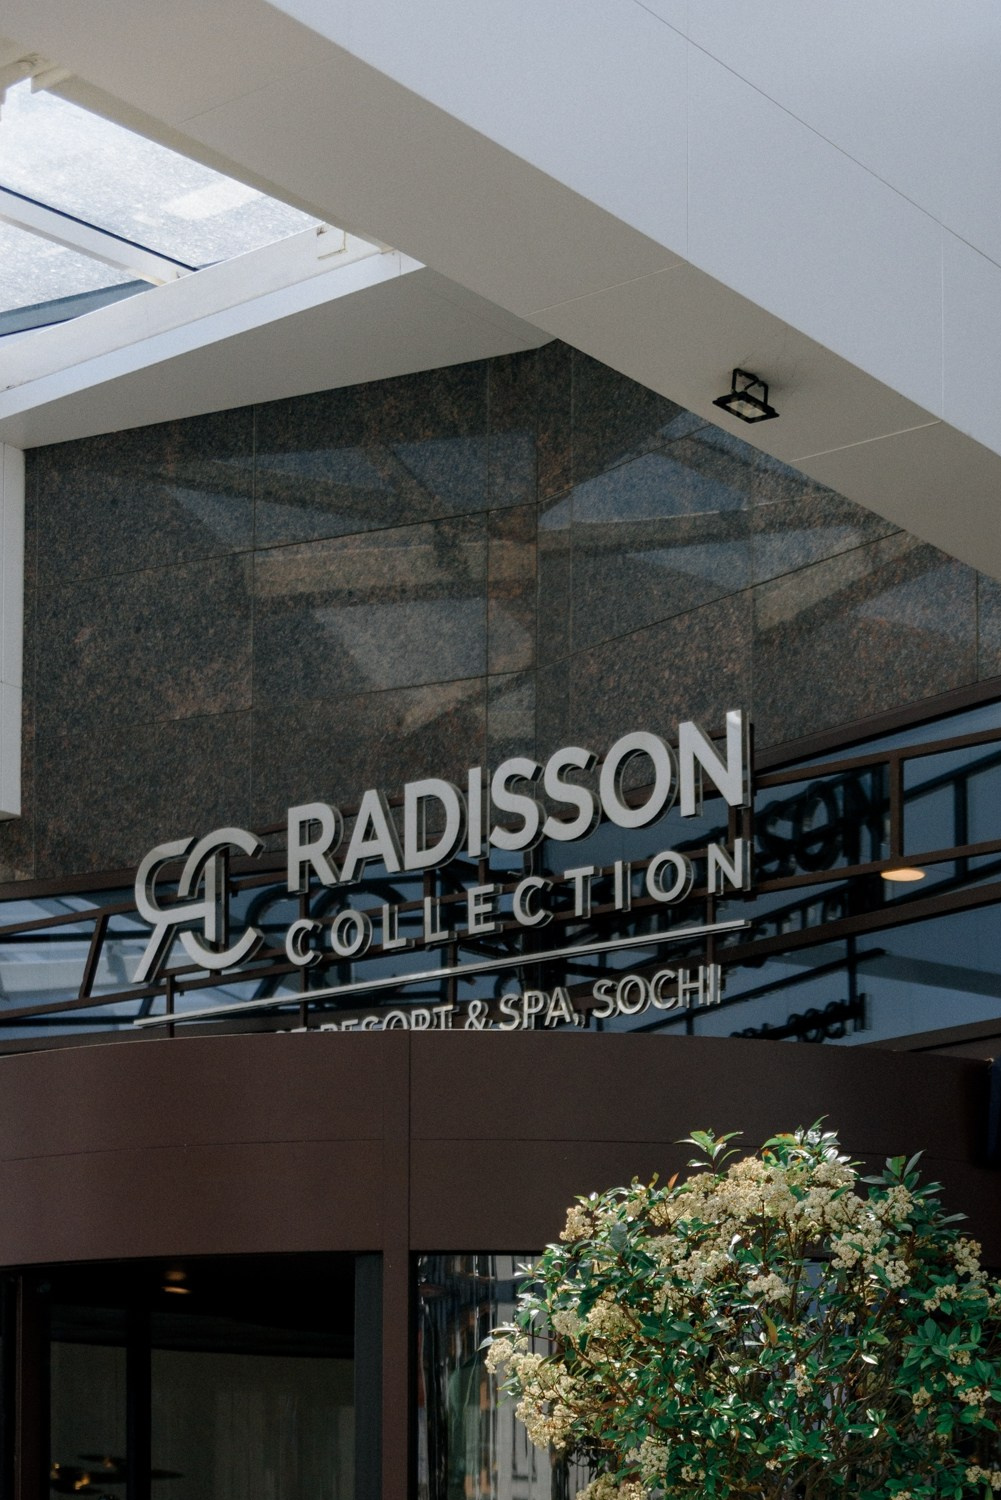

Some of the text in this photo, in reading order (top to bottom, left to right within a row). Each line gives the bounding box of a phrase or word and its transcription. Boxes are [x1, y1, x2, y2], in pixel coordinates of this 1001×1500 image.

[287, 708, 745, 895] RADISSON
[285, 838, 745, 967] COLLECTION
[499, 986, 585, 1031] SPA,
[592, 962, 721, 1019] SOCHI
